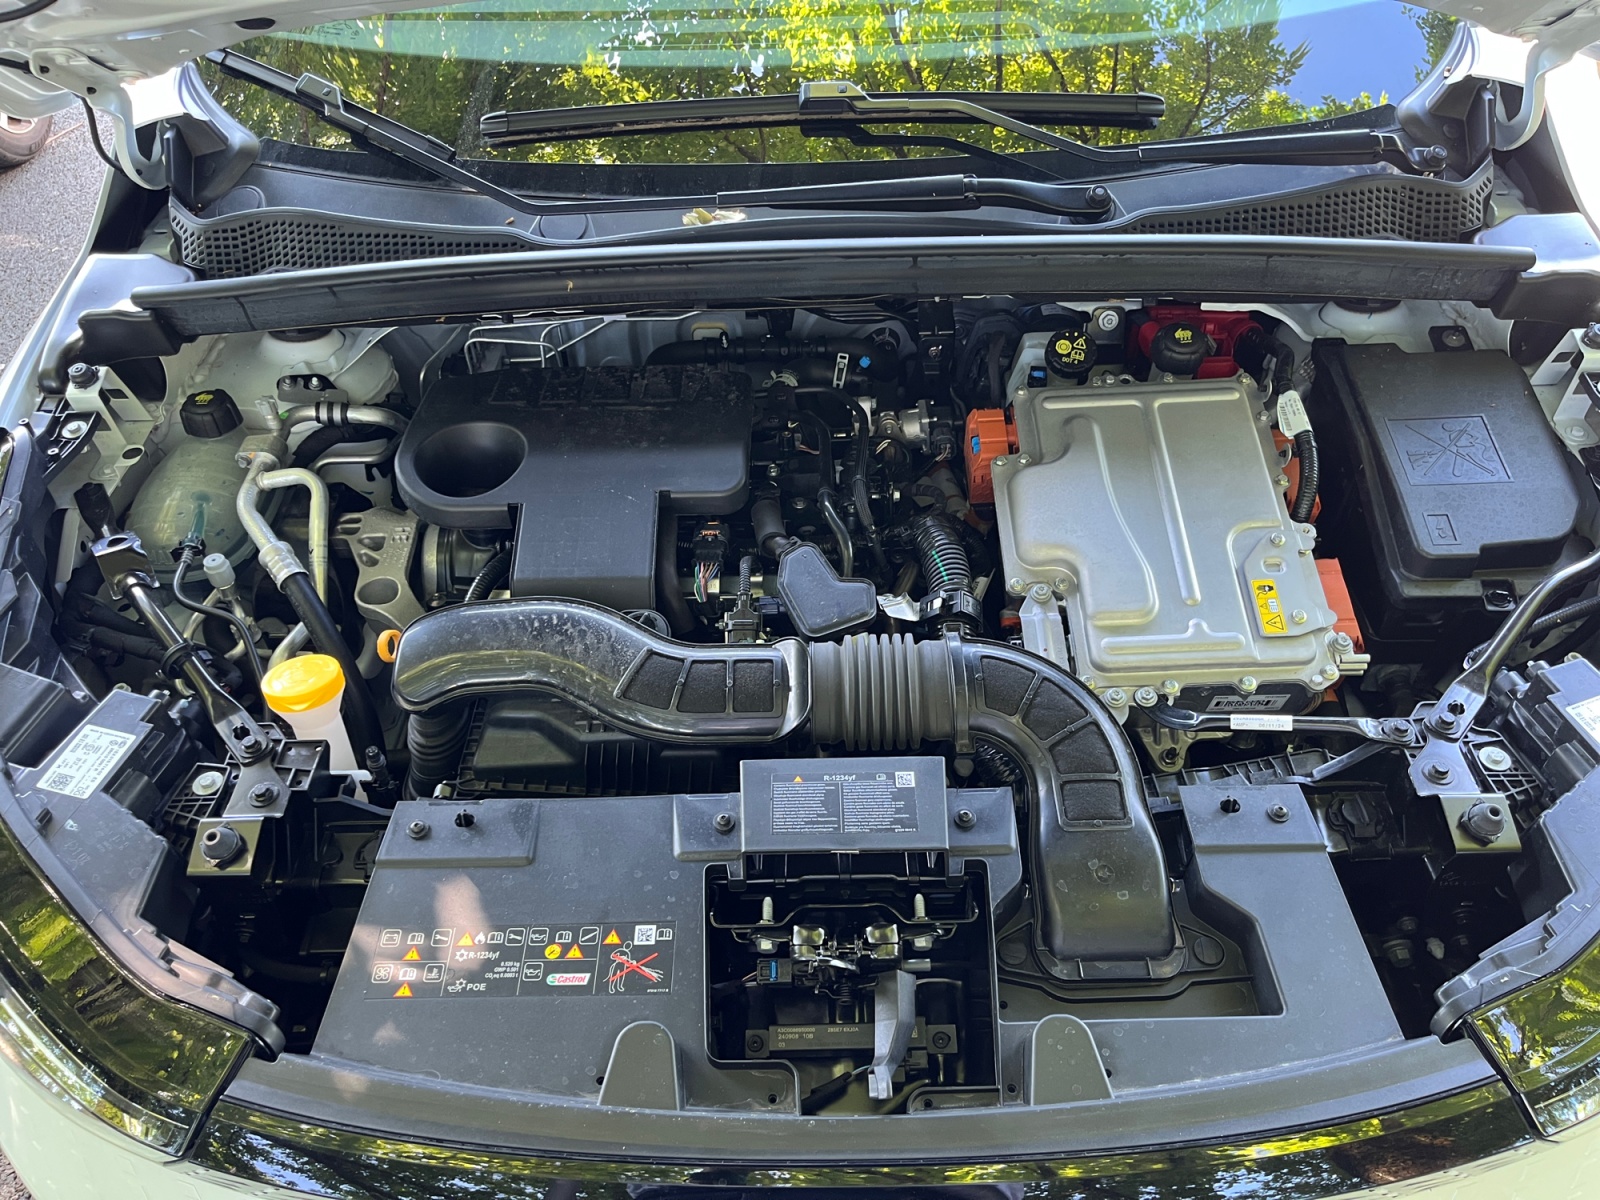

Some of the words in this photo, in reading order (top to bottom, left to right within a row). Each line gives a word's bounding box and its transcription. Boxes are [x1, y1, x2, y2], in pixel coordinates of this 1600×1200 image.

[1062, 356, 1073, 364] DOT
[823, 774, 856, 782] R-1234yf
[468, 951, 500, 960] R-1234yf
[556, 975, 587, 983] Castrol
[466, 983, 487, 991] POE
